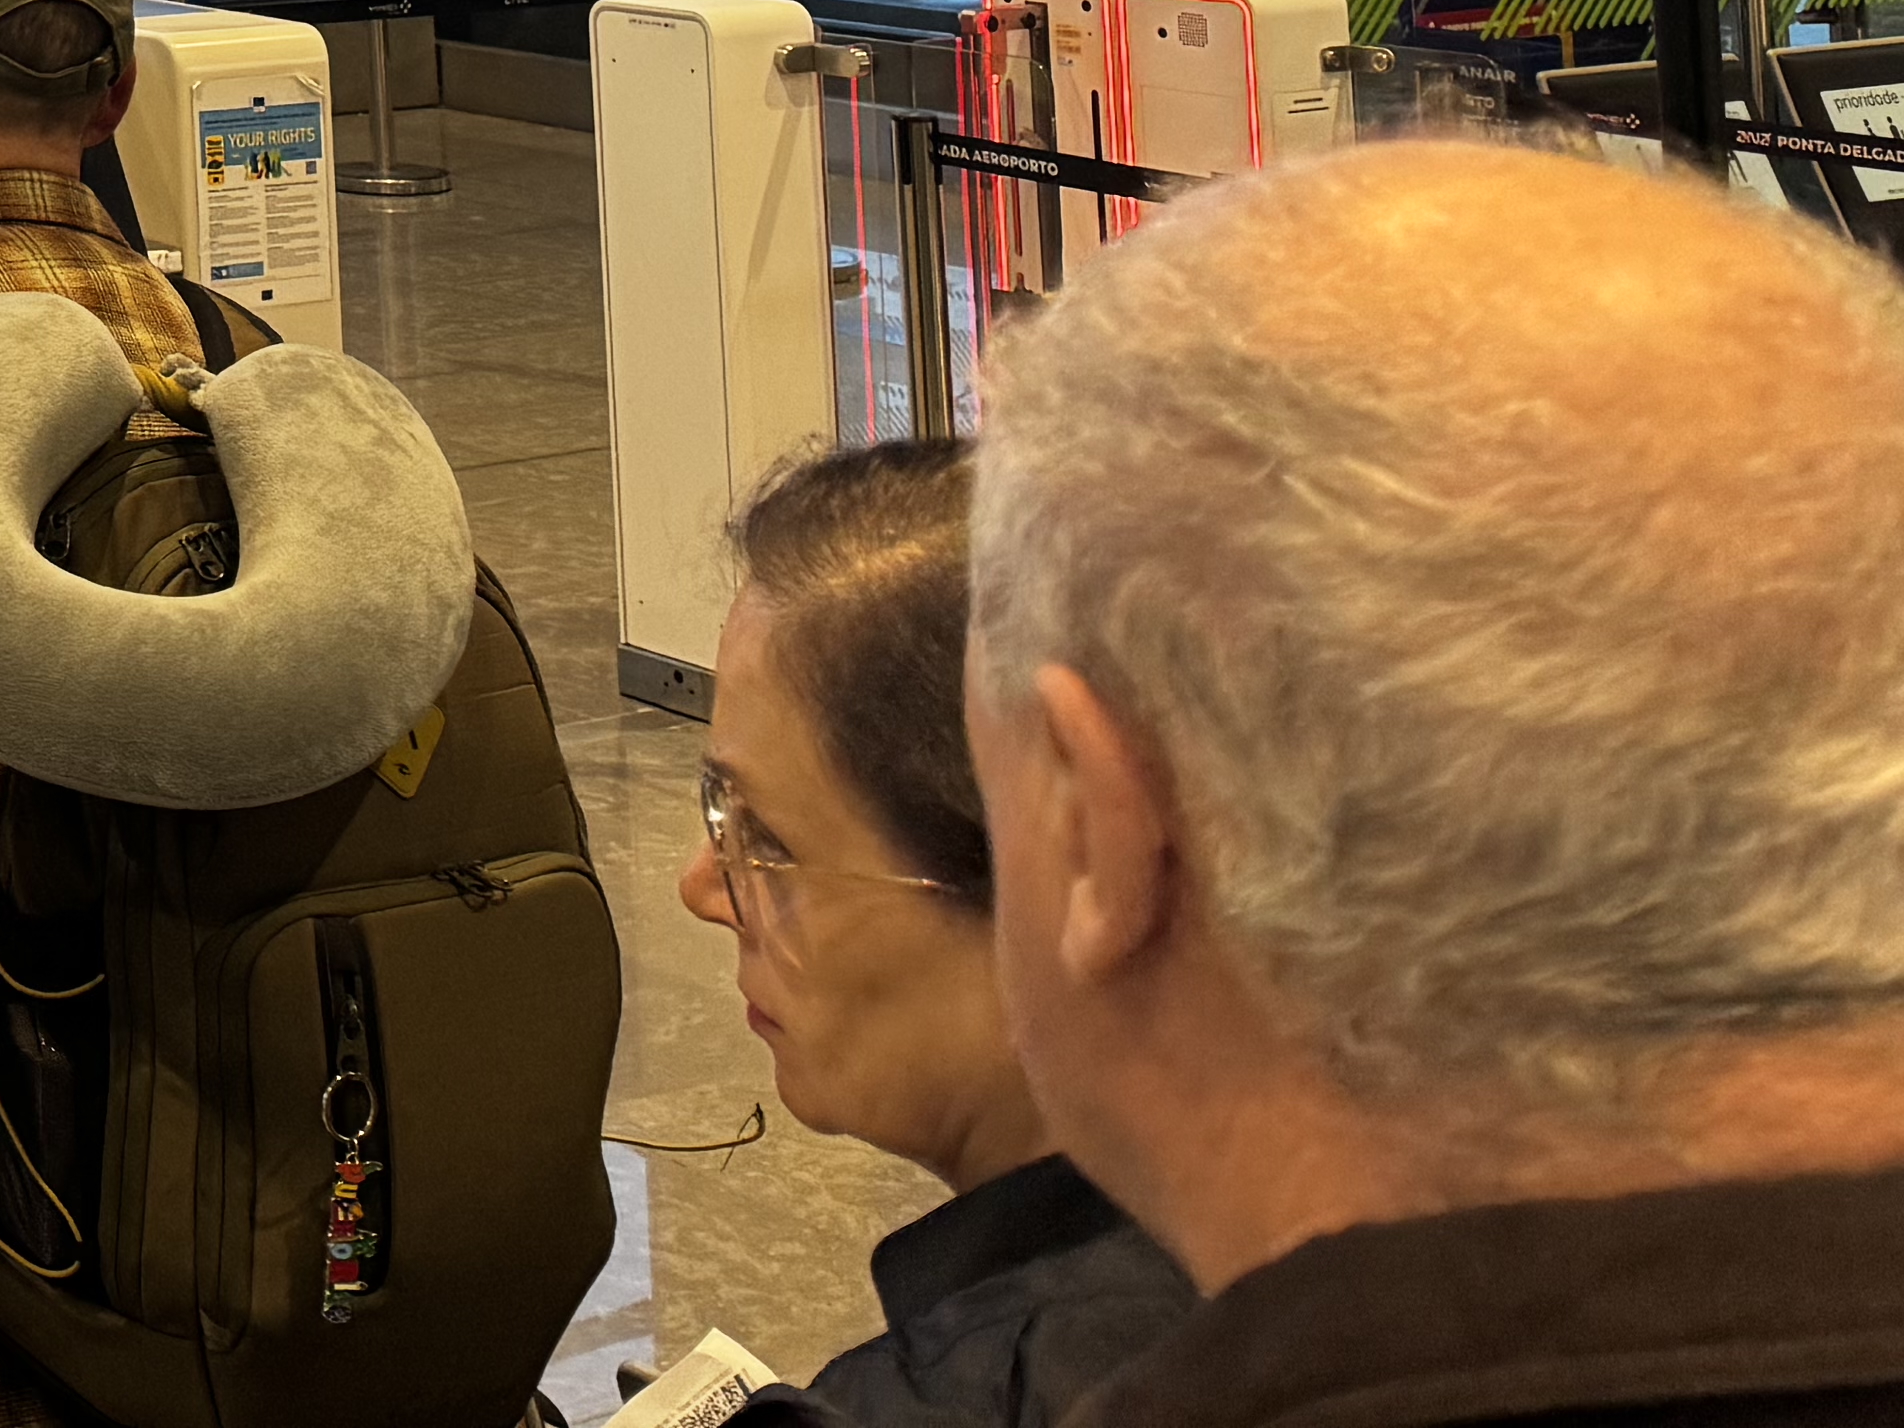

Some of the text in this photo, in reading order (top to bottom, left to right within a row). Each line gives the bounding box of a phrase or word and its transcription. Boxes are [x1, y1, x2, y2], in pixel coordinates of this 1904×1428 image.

[1833, 89, 1900, 113] prioridade
[228, 127, 316, 149] YOUR RIGHTS
[1777, 135, 1836, 154] PONTA
[972, 149, 1059, 176] AEROPORTO
